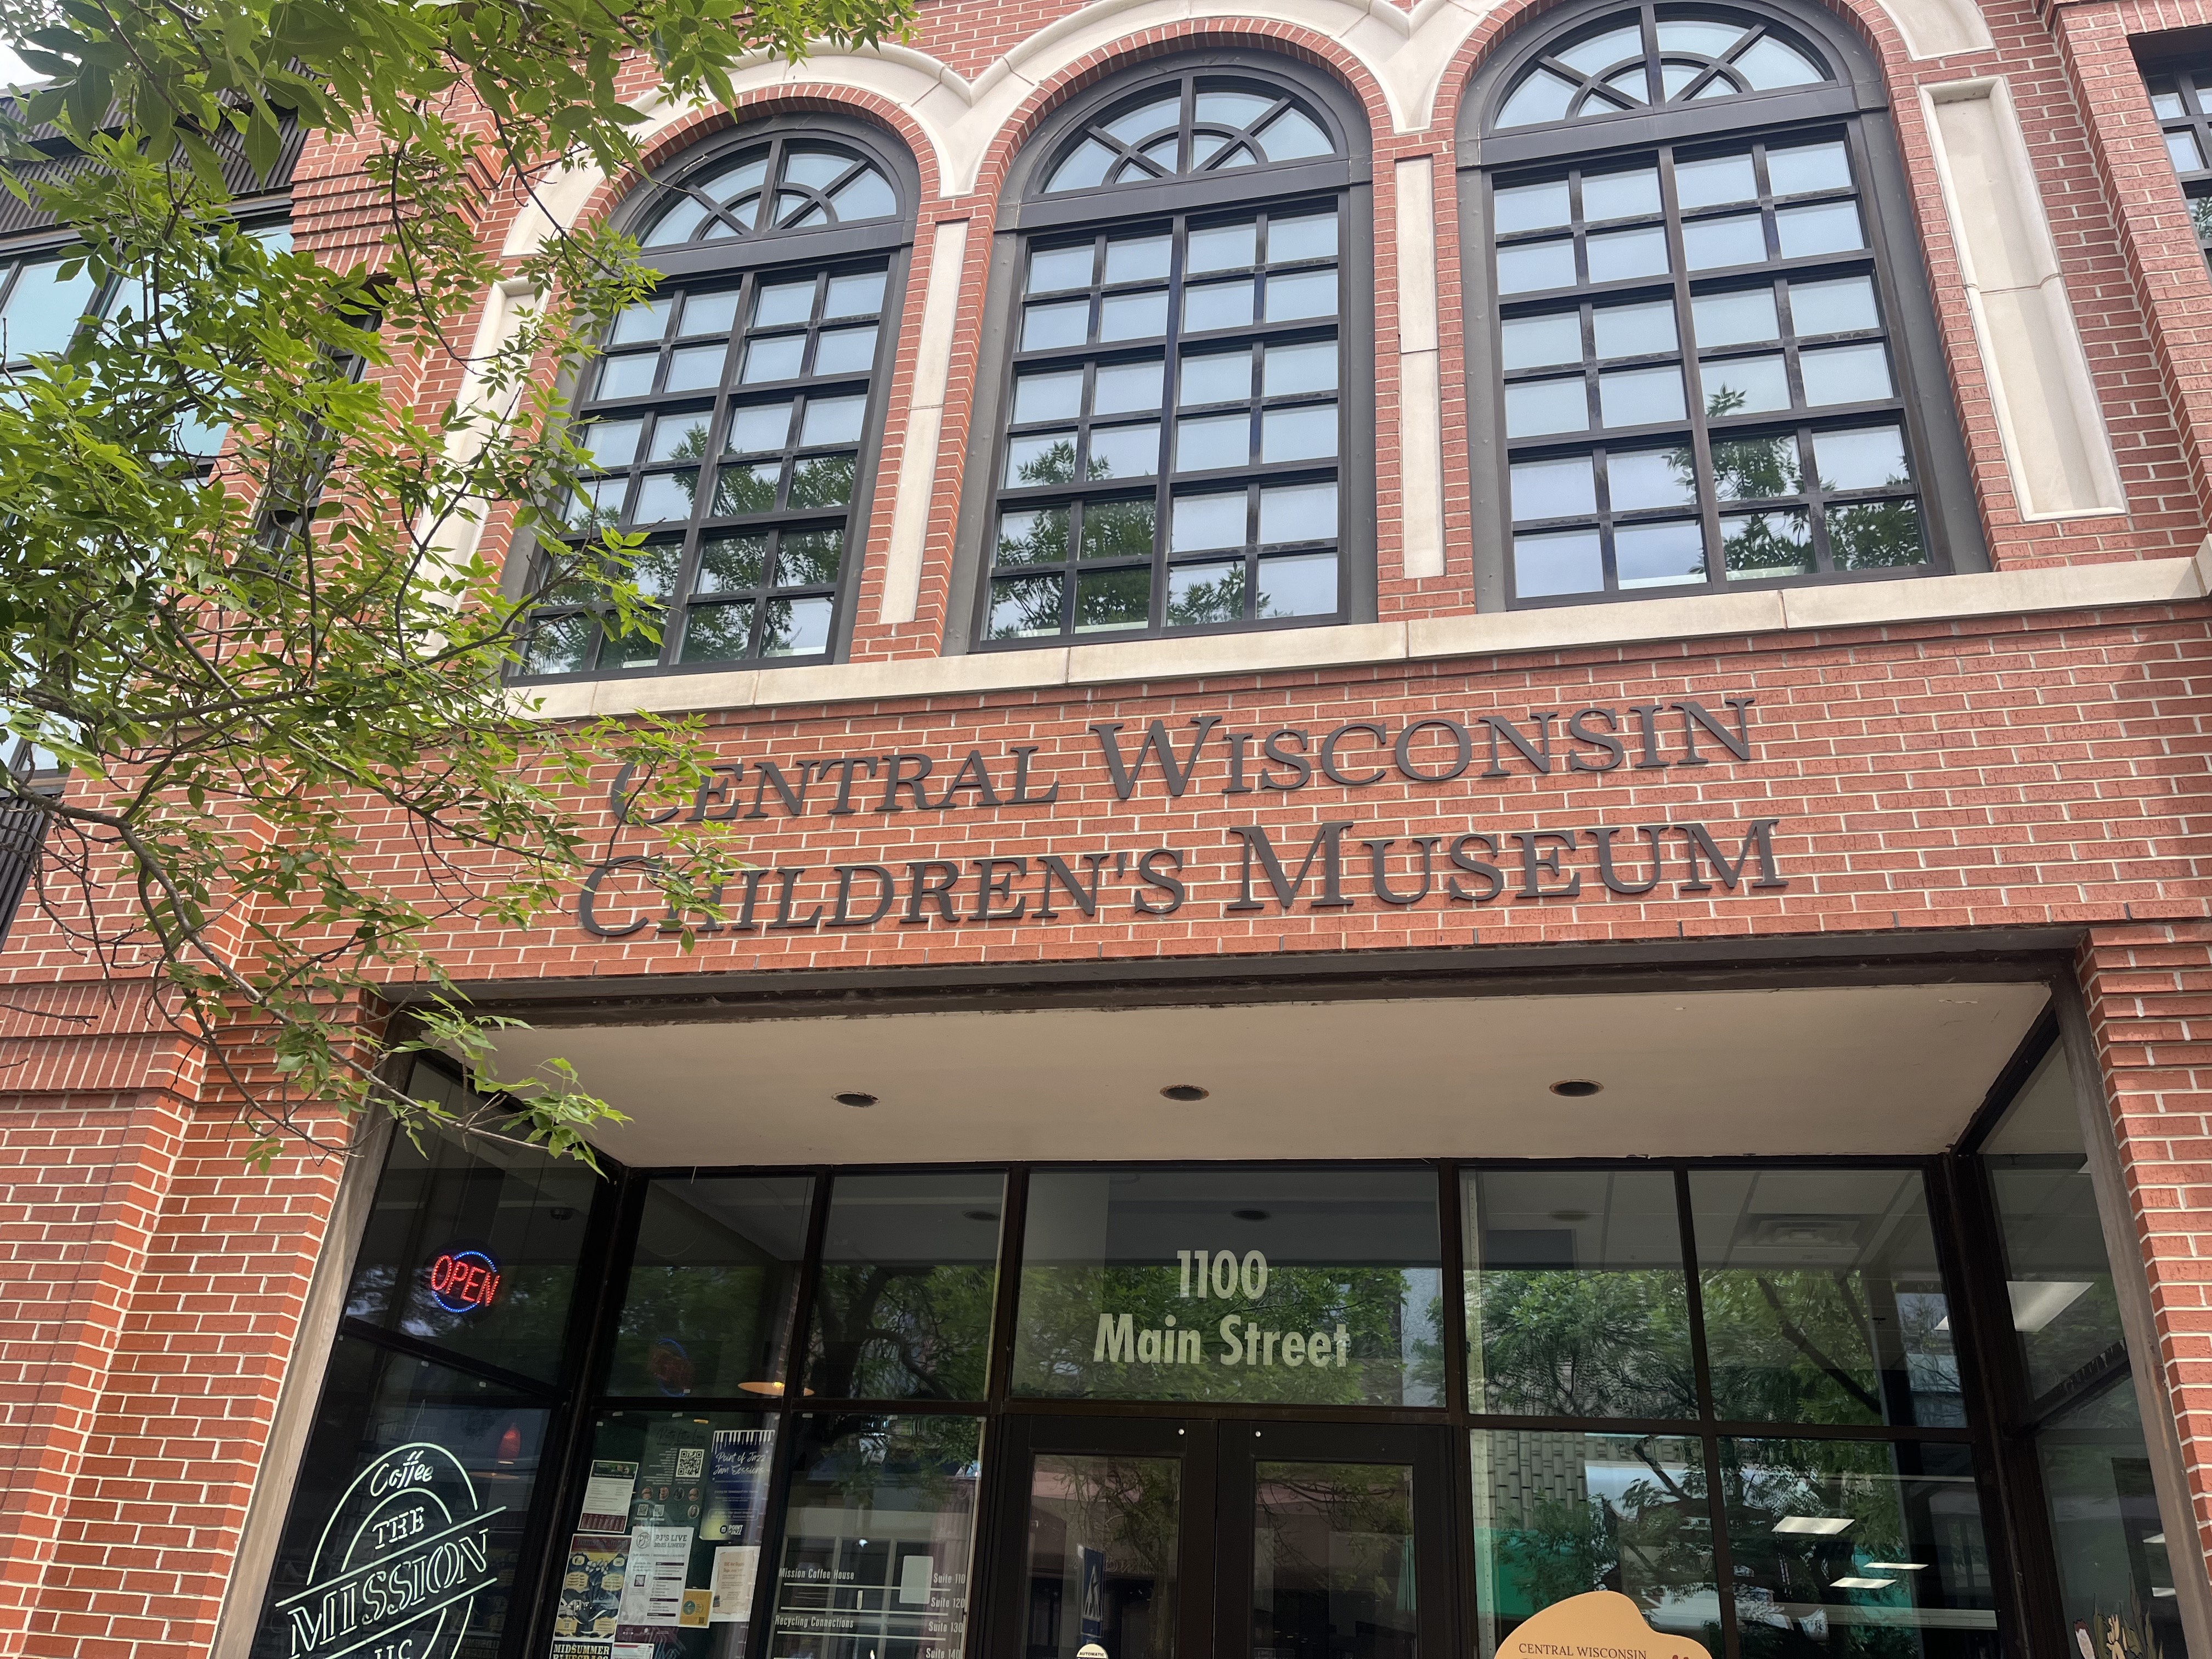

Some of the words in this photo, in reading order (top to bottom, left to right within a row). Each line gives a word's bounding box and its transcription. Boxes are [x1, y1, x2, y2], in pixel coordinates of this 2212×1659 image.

[611, 746, 1059, 826] CENTRAL
[1089, 697, 1756, 800] WISCONSIN
[1227, 818, 1790, 911] MUSEUM
[431, 1255, 501, 1307] OPEN
[1176, 1249, 1268, 1300] 1100
[1093, 1313, 1201, 1364] Main
[1220, 1314, 1351, 1368] Street
[715, 1451, 737, 1463] Point
[737, 1452, 746, 1464] of
[747, 1451, 766, 1463] Jazz
[370, 1450, 434, 1497] Coffee
[713, 1464, 729, 1476] Jam
[731, 1464, 765, 1476] Sessions
[372, 1506, 425, 1550] THE
[778, 1567, 805, 1578] Mission
[808, 1568, 831, 1579] Coffee
[833, 1569, 855, 1580] House
[933, 1573, 952, 1584] Suite
[955, 1573, 966, 1584] 110
[287, 1528, 489, 1659] MISSION
[930, 1597, 950, 1608] Suite
[953, 1598, 965, 1609] 120
[775, 1615, 808, 1628] Recycling
[811, 1616, 854, 1628] Connections
[928, 1621, 947, 1632] Suite
[951, 1622, 963, 1633] 130
[553, 1644, 610, 1655] MIDSUMMER
[926, 1647, 945, 1659] Suite
[948, 1649, 961, 1659] 140
[1519, 1643, 1574, 1657] CENTRAL
[1577, 1646, 1646, 1659] WISCONSIN
